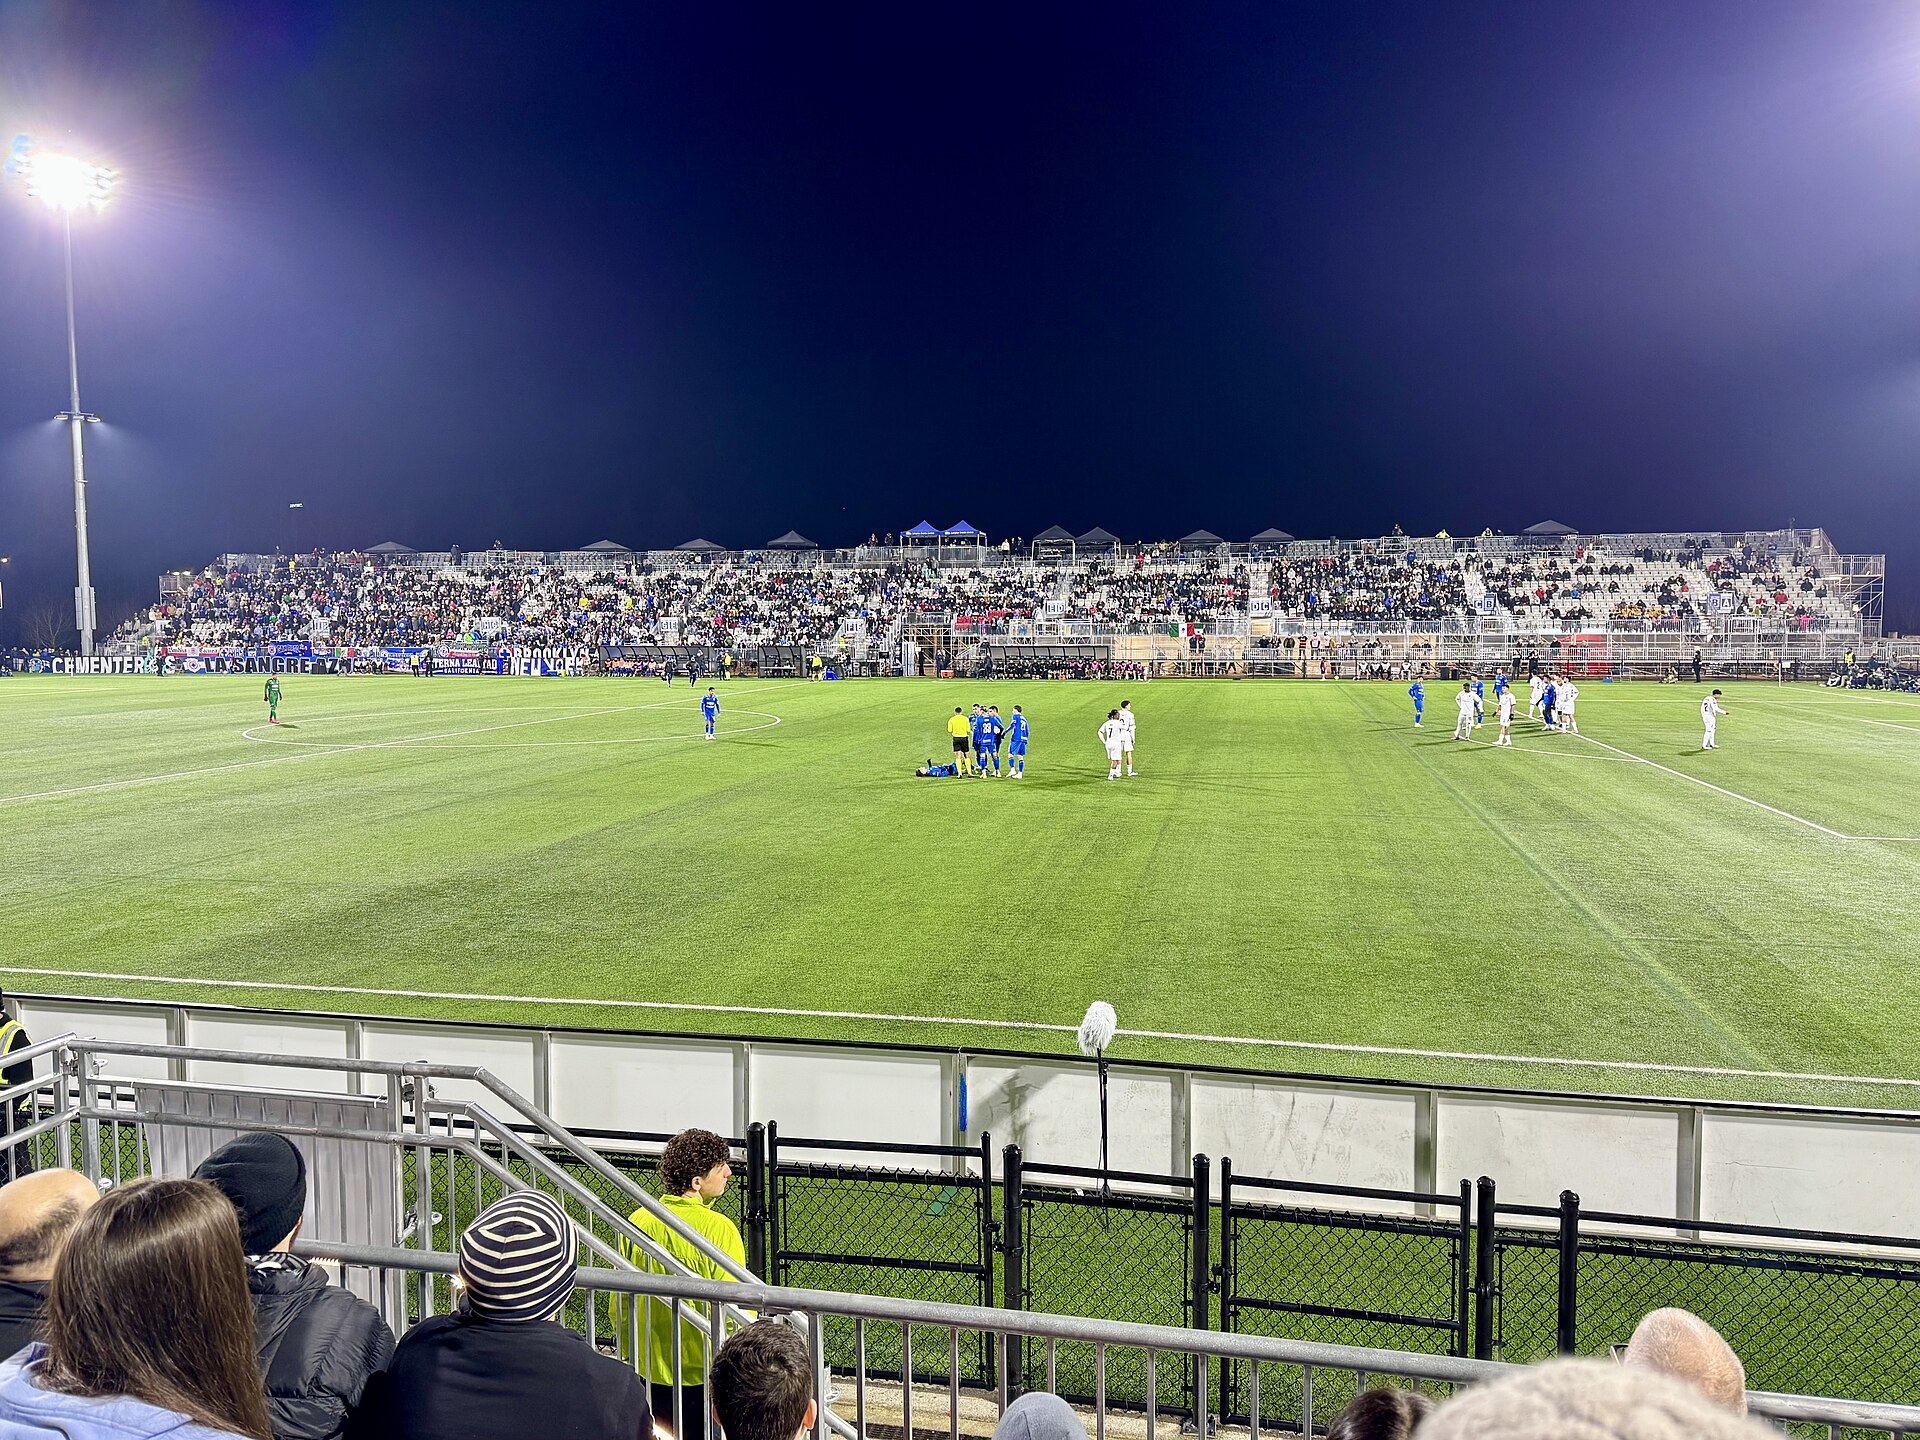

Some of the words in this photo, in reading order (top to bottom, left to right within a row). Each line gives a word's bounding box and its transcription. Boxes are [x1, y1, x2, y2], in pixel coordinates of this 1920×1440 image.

[514, 645, 590, 660] BROOKLYN
[233, 657, 311, 674] SANGRE
[511, 659, 541, 677] NEW
